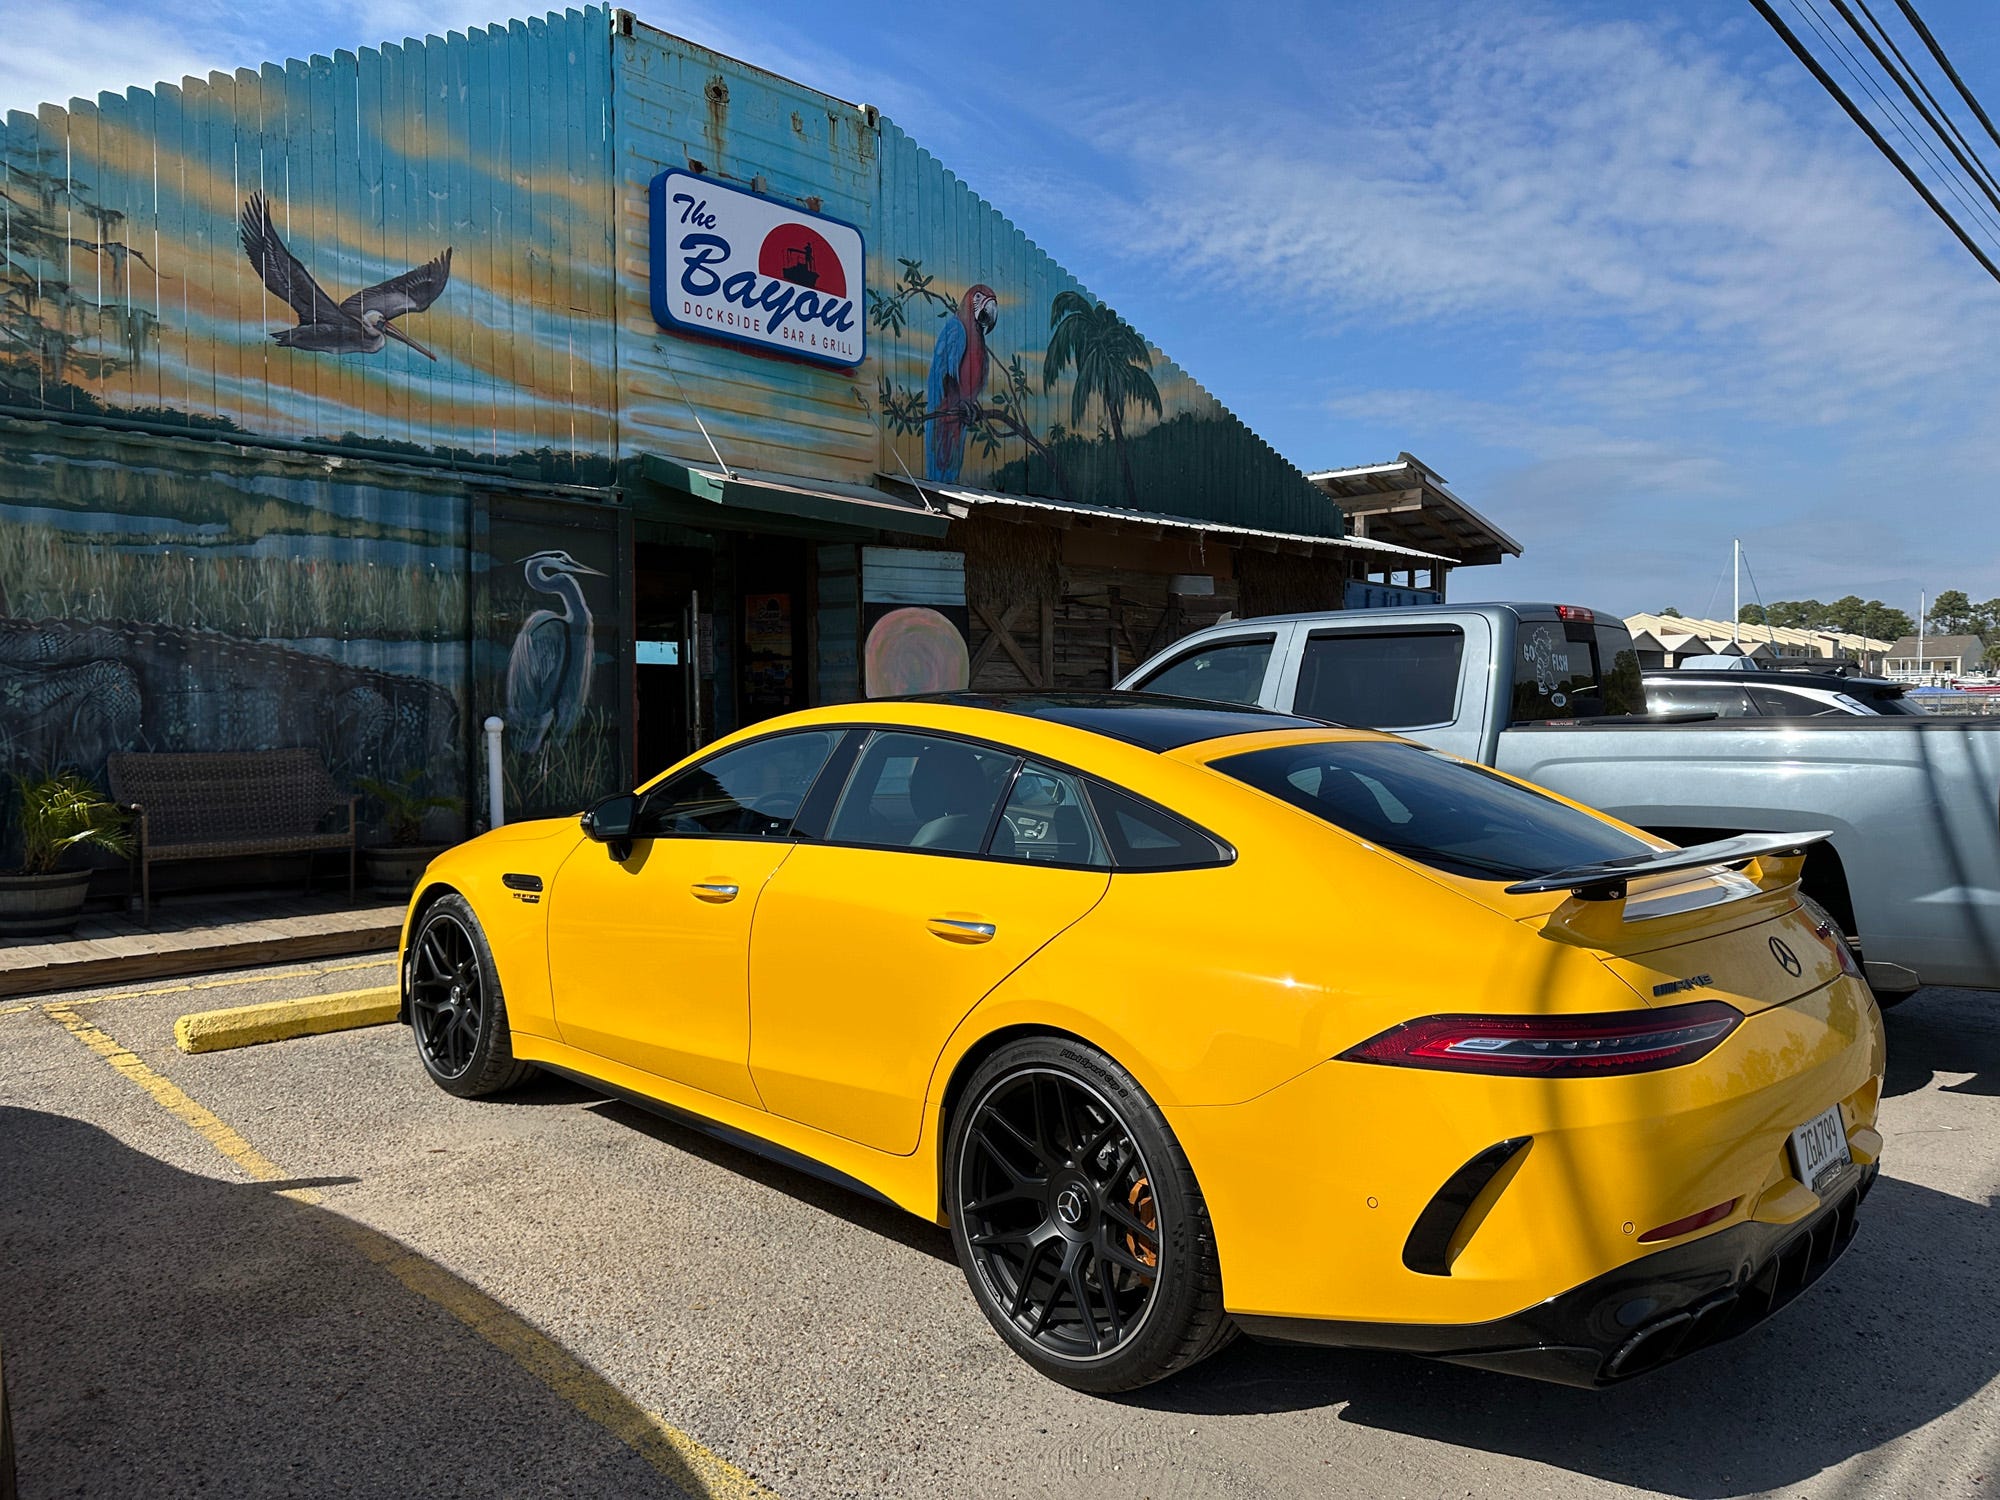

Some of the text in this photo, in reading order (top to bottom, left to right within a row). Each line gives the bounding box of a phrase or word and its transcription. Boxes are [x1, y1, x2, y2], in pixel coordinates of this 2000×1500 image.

[672, 193, 717, 230] The
[680, 233, 855, 335] Bayou
[684, 301, 853, 355] DOCKSIDE BAR & GRILL
[1523, 643, 1536, 662] GO
[1551, 653, 1569, 672] FISH
[1060, 1048, 1082, 1063] Pilot
[1080, 1058, 1107, 1080] Sport
[1104, 1075, 1120, 1092] Cup
[1800, 1114, 1838, 1170] ZGA799
